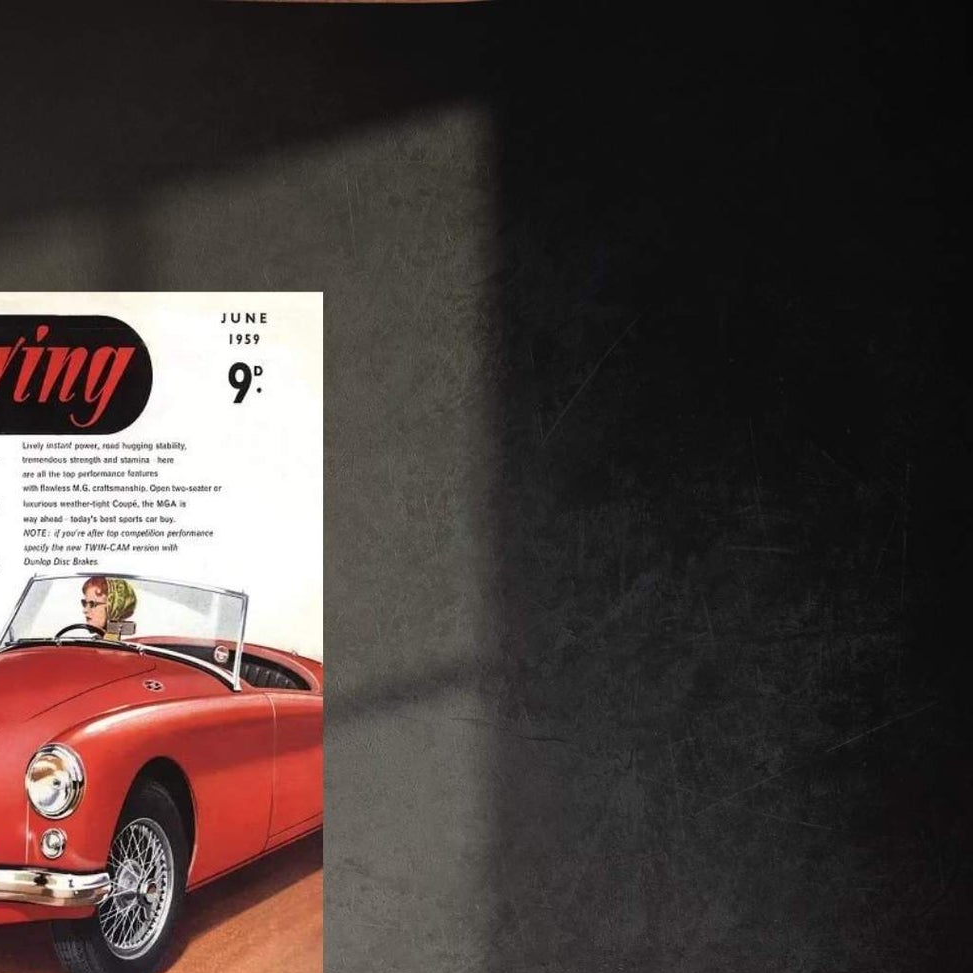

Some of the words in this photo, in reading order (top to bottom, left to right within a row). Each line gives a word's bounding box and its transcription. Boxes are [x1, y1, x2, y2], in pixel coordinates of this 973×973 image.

[221, 313, 267, 323] JUNE
[229, 334, 260, 344] 1959
[22, 442, 44, 450] Lively
[46, 442, 72, 450] instant
[75, 442, 100, 450] power,
[102, 442, 119, 450] road
[122, 442, 153, 450] hugging
[156, 442, 187, 450] stability,
[22, 456, 67, 464] tremendous
[70, 456, 101, 464] strength
[103, 456, 118, 464] and
[120, 456, 150, 464] stamina
[157, 456, 174, 464] here
[22, 470, 35, 478] are
[37, 470, 46, 478] all
[49, 470, 60, 478] the
[63, 470, 75, 478] top
[78, 470, 125, 478] performance
[128, 470, 158, 478] features
[22, 485, 38, 493] with
[40, 485, 70, 493] flawless
[150, 485, 170, 493] Open
[172, 485, 211, 493] two-seater
[213, 485, 222, 493] or
[23, 500, 57, 508] luxurious
[60, 500, 110, 508] weather-tight
[142, 500, 154, 508] the
[157, 500, 176, 508] MGA
[179, 500, 186, 508] is
[23, 515, 37, 523] way
[40, 515, 63, 523] ahead
[70, 515, 97, 523] today's
[100, 515, 116, 523] best
[119, 515, 144, 523] sports
[146, 515, 157, 523] car
[54, 529, 60, 538] if
[62, 529, 85, 538] you're
[87, 529, 104, 538] after
[107, 529, 119, 538] top
[121, 529, 164, 538] competition
[167, 529, 213, 538] performance
[23, 544, 49, 552] specify
[52, 544, 64, 552] the
[66, 544, 81, 552] new
[85, 544, 130, 552] TWIN-CAM
[132, 544, 159, 552] version
[162, 544, 179, 552] with
[23, 558, 51, 566] Dunlop
[54, 558, 70, 566] Disc
